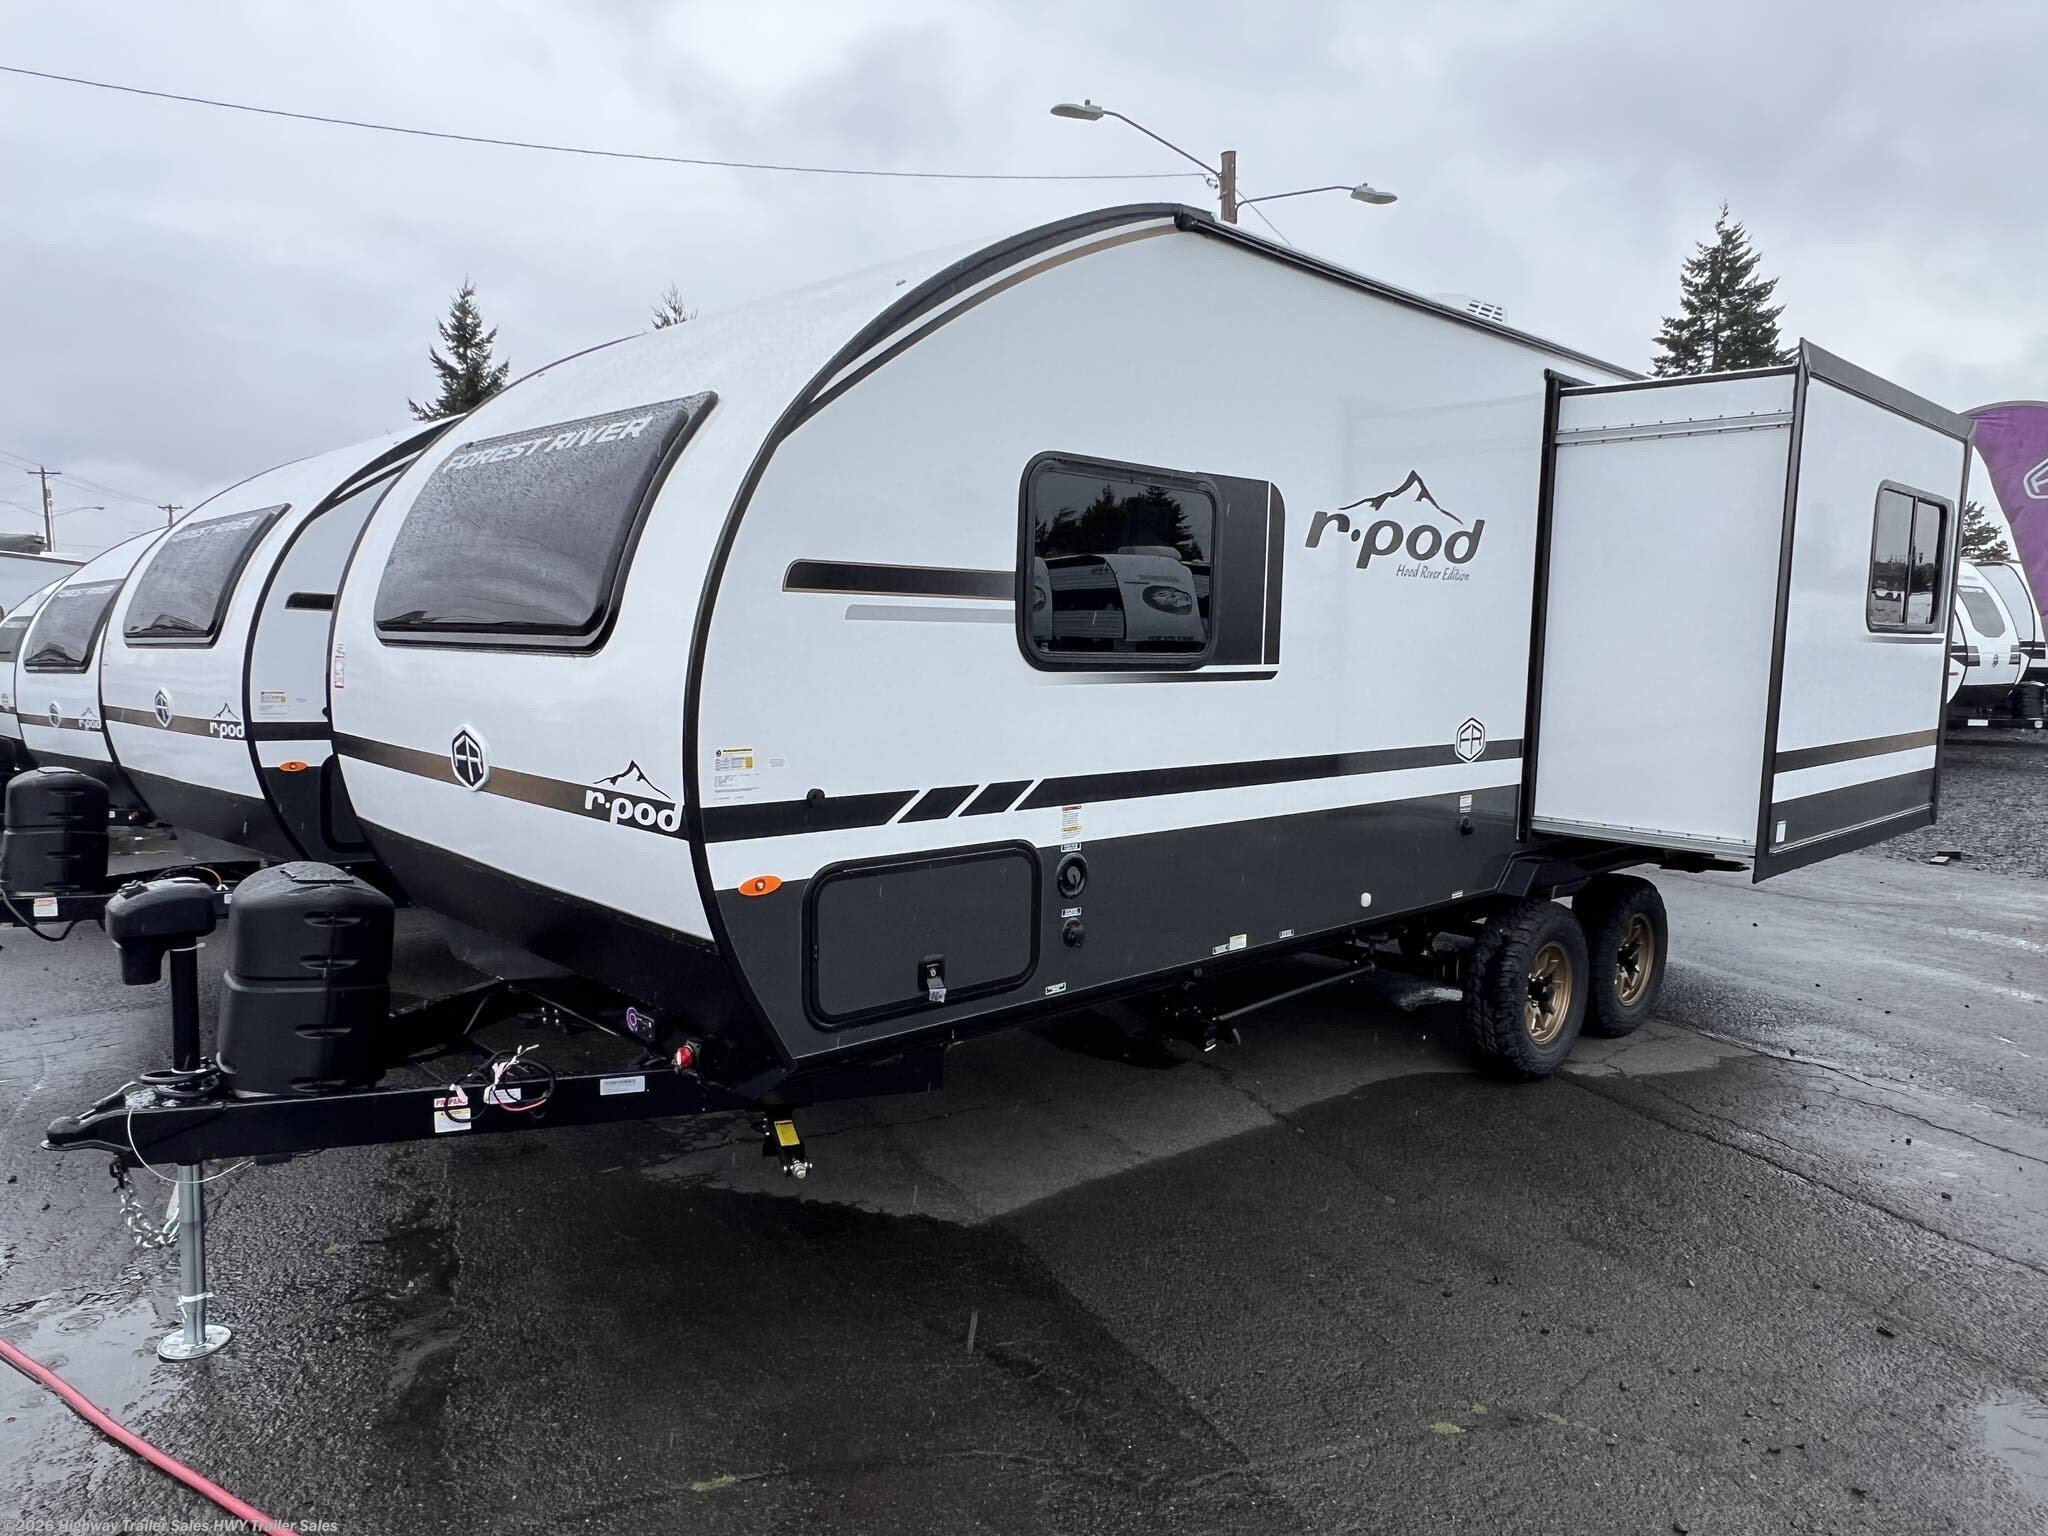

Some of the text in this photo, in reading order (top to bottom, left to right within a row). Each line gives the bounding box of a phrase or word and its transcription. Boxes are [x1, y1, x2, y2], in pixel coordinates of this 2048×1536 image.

[442, 415, 654, 474] FOREST RIVER
[1420, 565, 1442, 579] River
